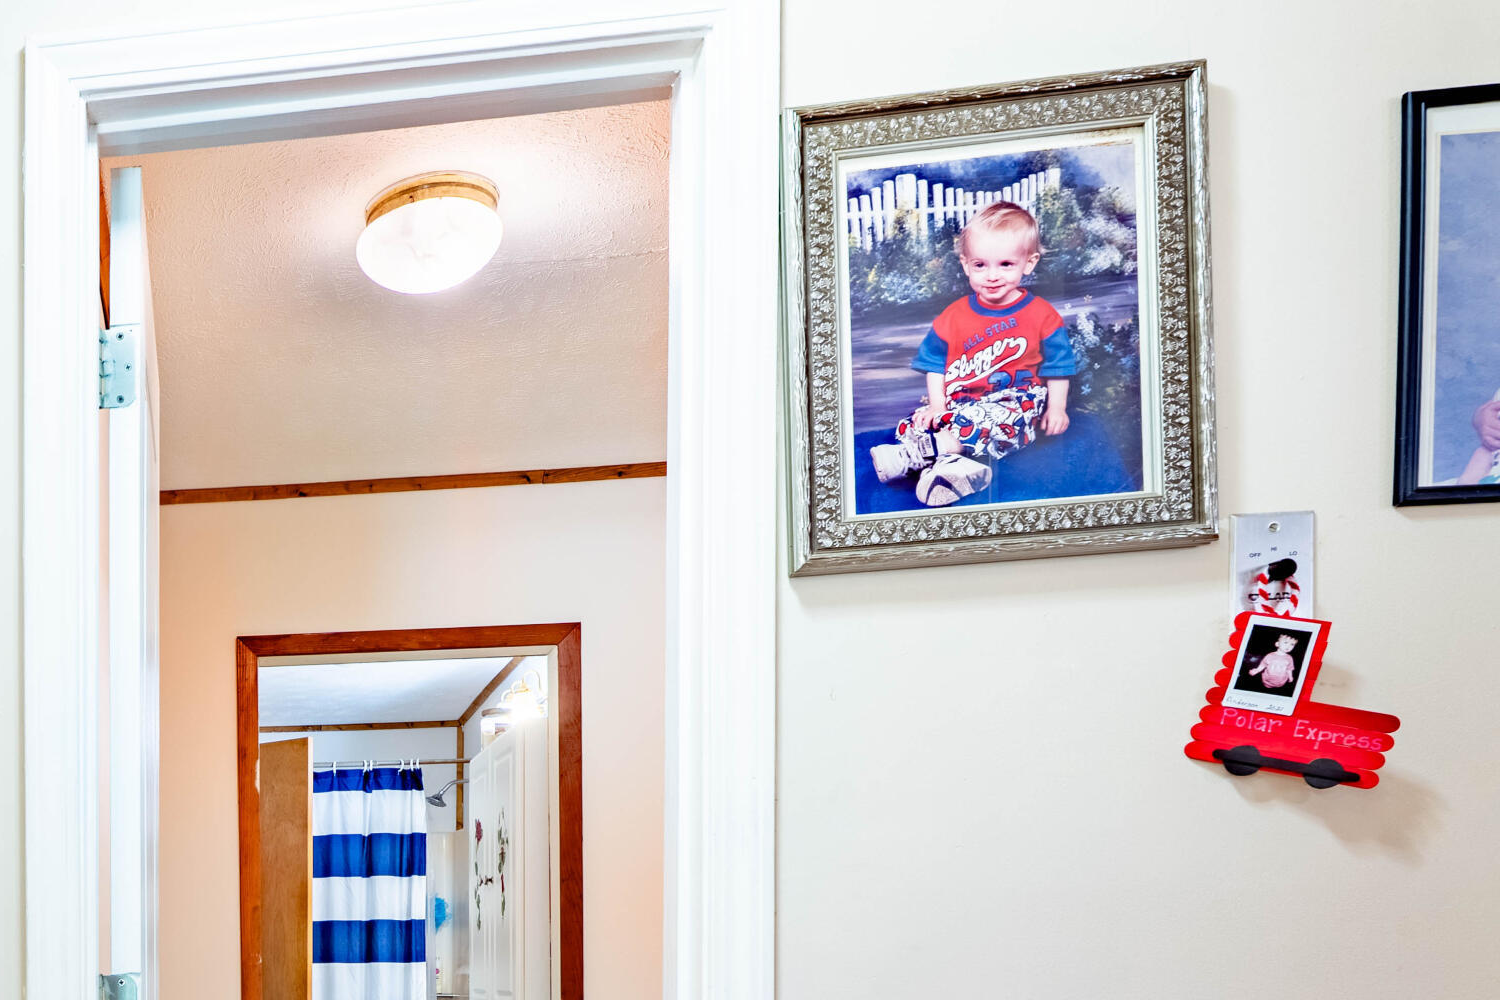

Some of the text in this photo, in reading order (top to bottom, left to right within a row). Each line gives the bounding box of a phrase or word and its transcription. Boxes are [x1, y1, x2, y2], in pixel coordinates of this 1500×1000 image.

[963, 317, 1018, 352] ALL STAR
[945, 336, 1028, 387] Slugger
[1220, 707, 1383, 750] Polar Express
